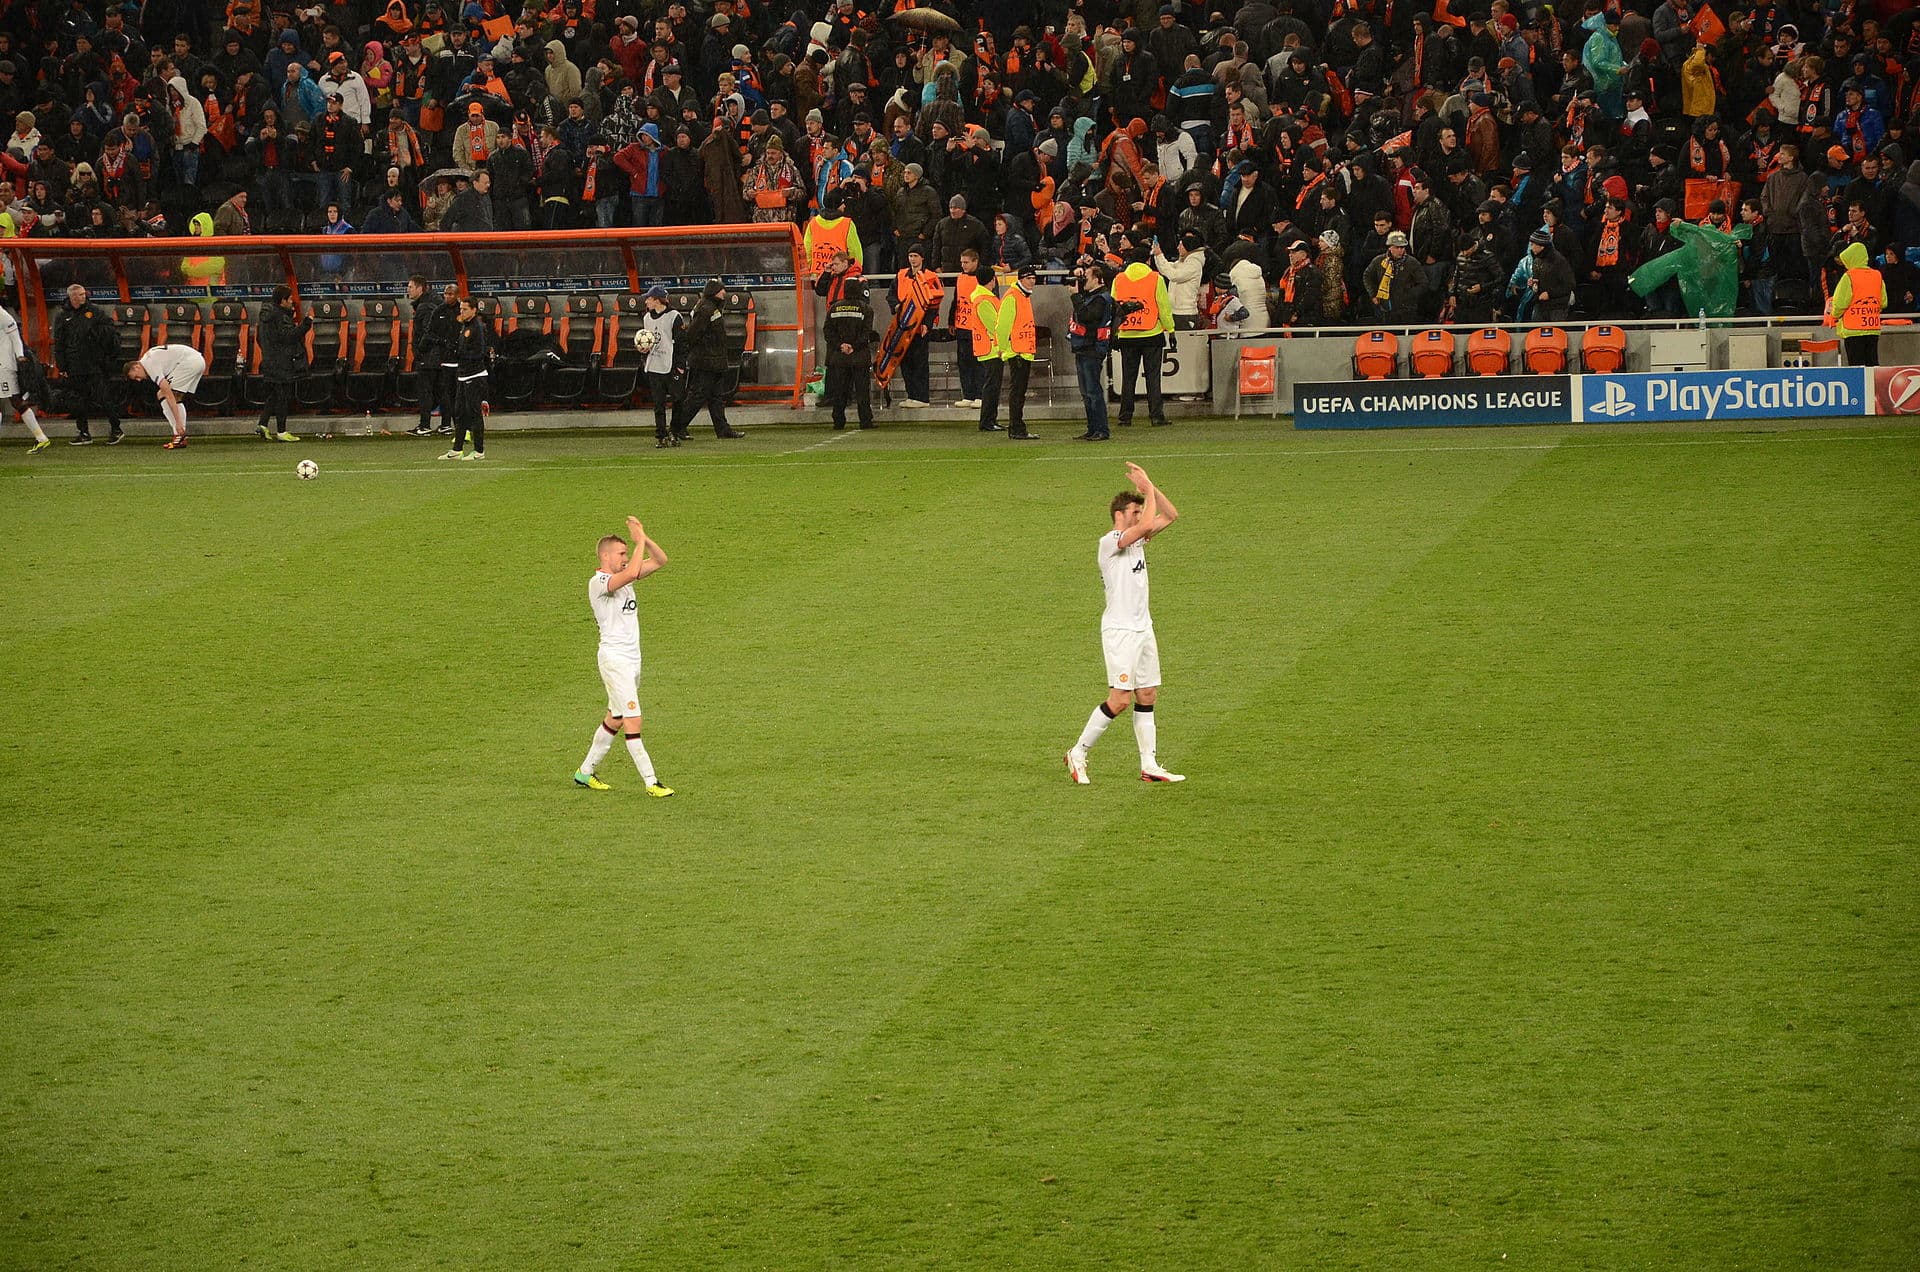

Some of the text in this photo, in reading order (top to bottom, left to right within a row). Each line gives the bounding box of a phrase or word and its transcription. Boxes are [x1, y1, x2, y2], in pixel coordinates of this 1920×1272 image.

[1019, 331, 1034, 340] STE
[1162, 348, 1180, 376] 5
[1302, 391, 1562, 414] UEFA CHAMPIONS LEAGUE
[1646, 375, 1848, 420] PlayStation
